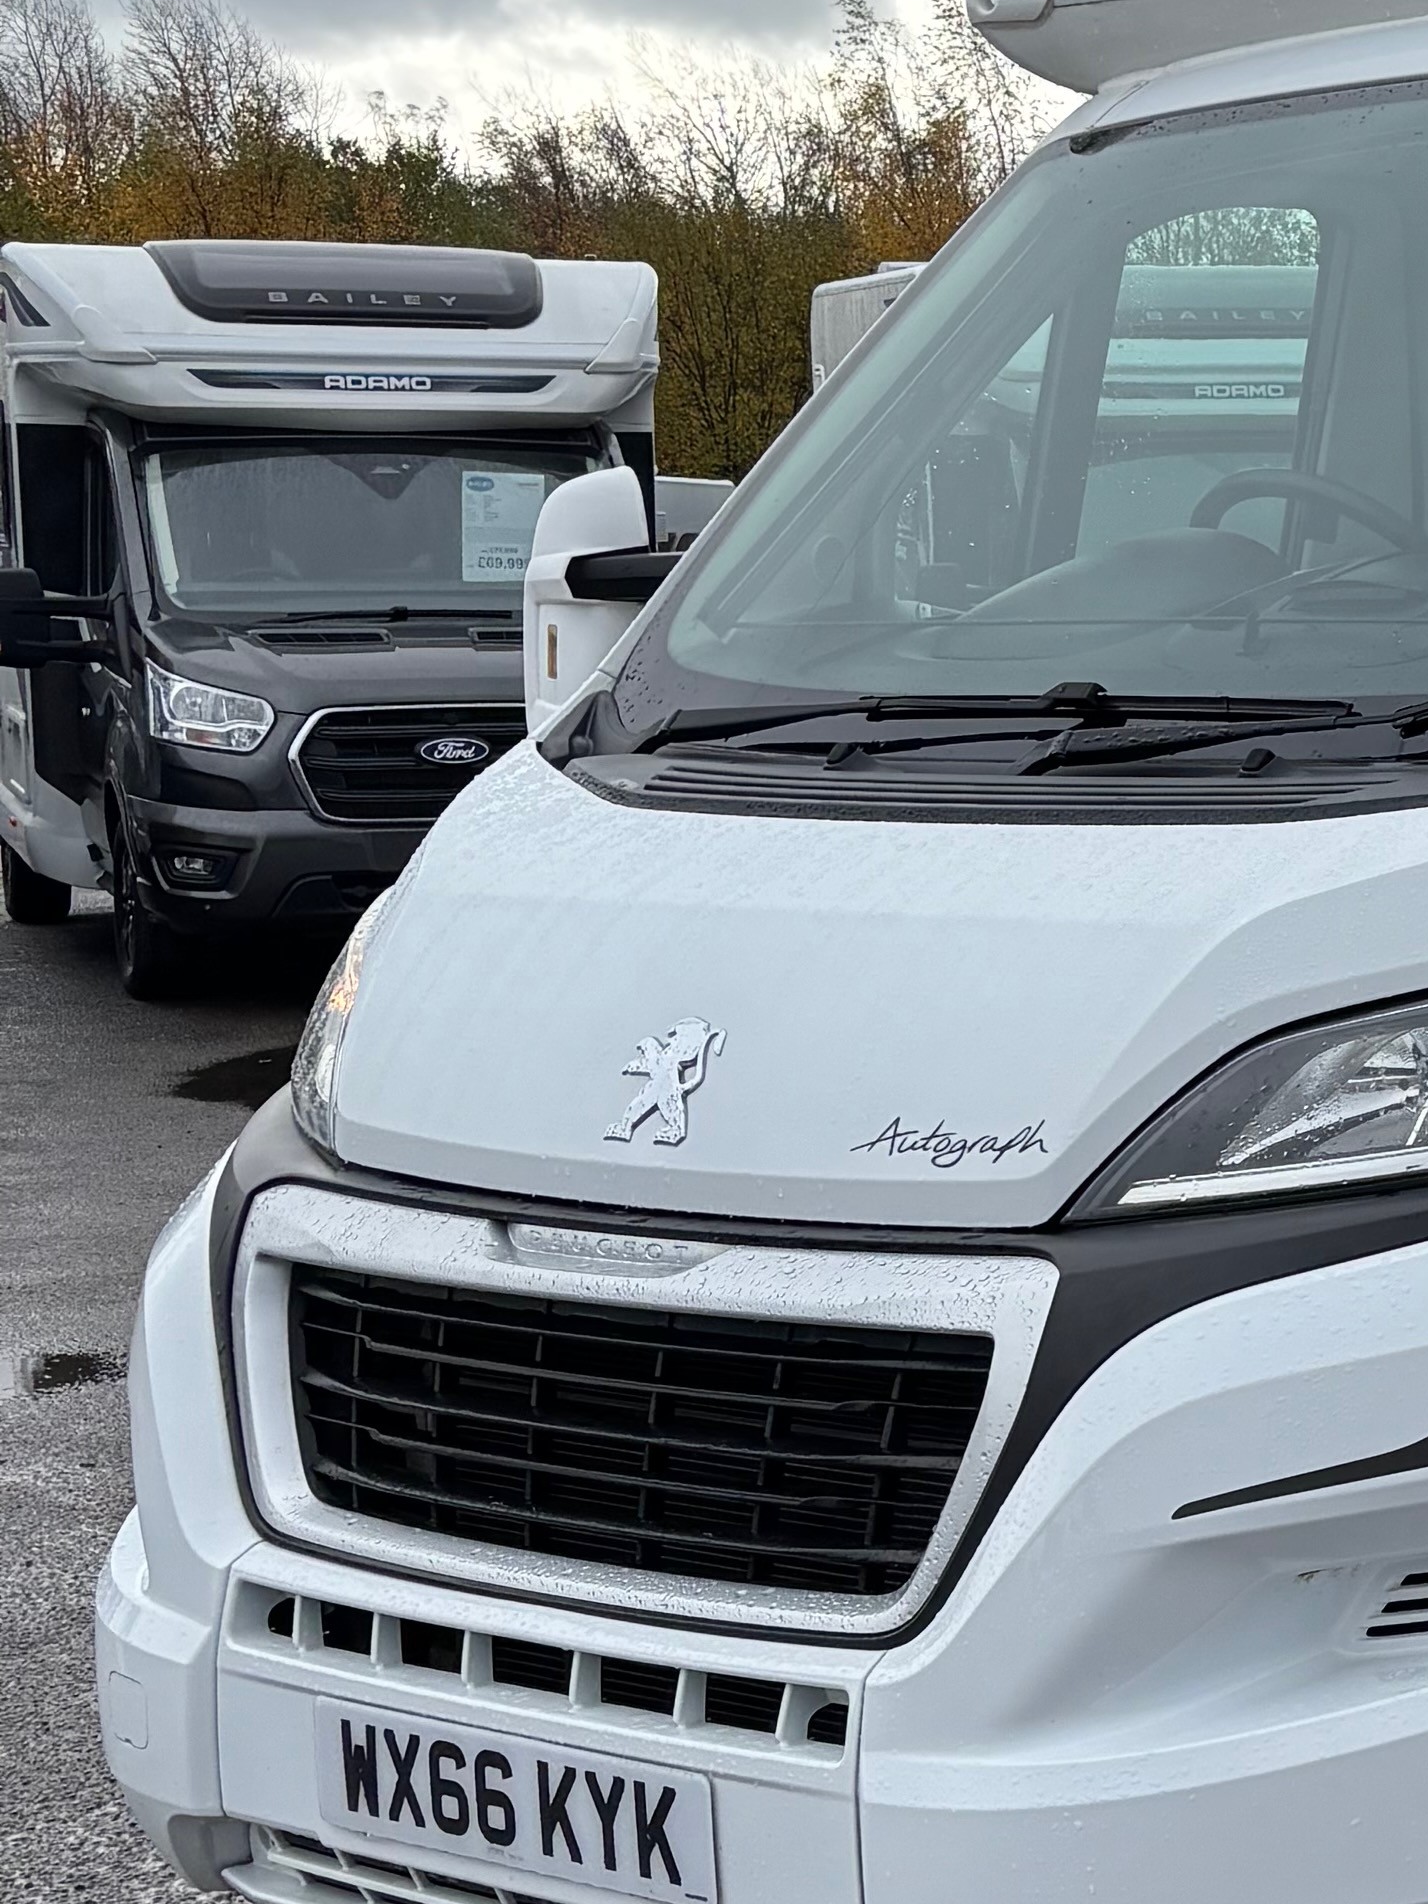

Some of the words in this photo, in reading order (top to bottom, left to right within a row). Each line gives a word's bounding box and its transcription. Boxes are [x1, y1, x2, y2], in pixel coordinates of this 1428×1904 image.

[268, 291, 457, 307] BAILEY
[1145, 309, 1305, 321] BAILEY
[323, 375, 432, 391] ADAMO
[1194, 384, 1285, 398] ADAMO
[433, 742, 476, 759] Ford
[849, 1116, 1049, 1169] Autograph
[340, 1718, 516, 1847] WX66
[536, 1759, 683, 1887] KYK
